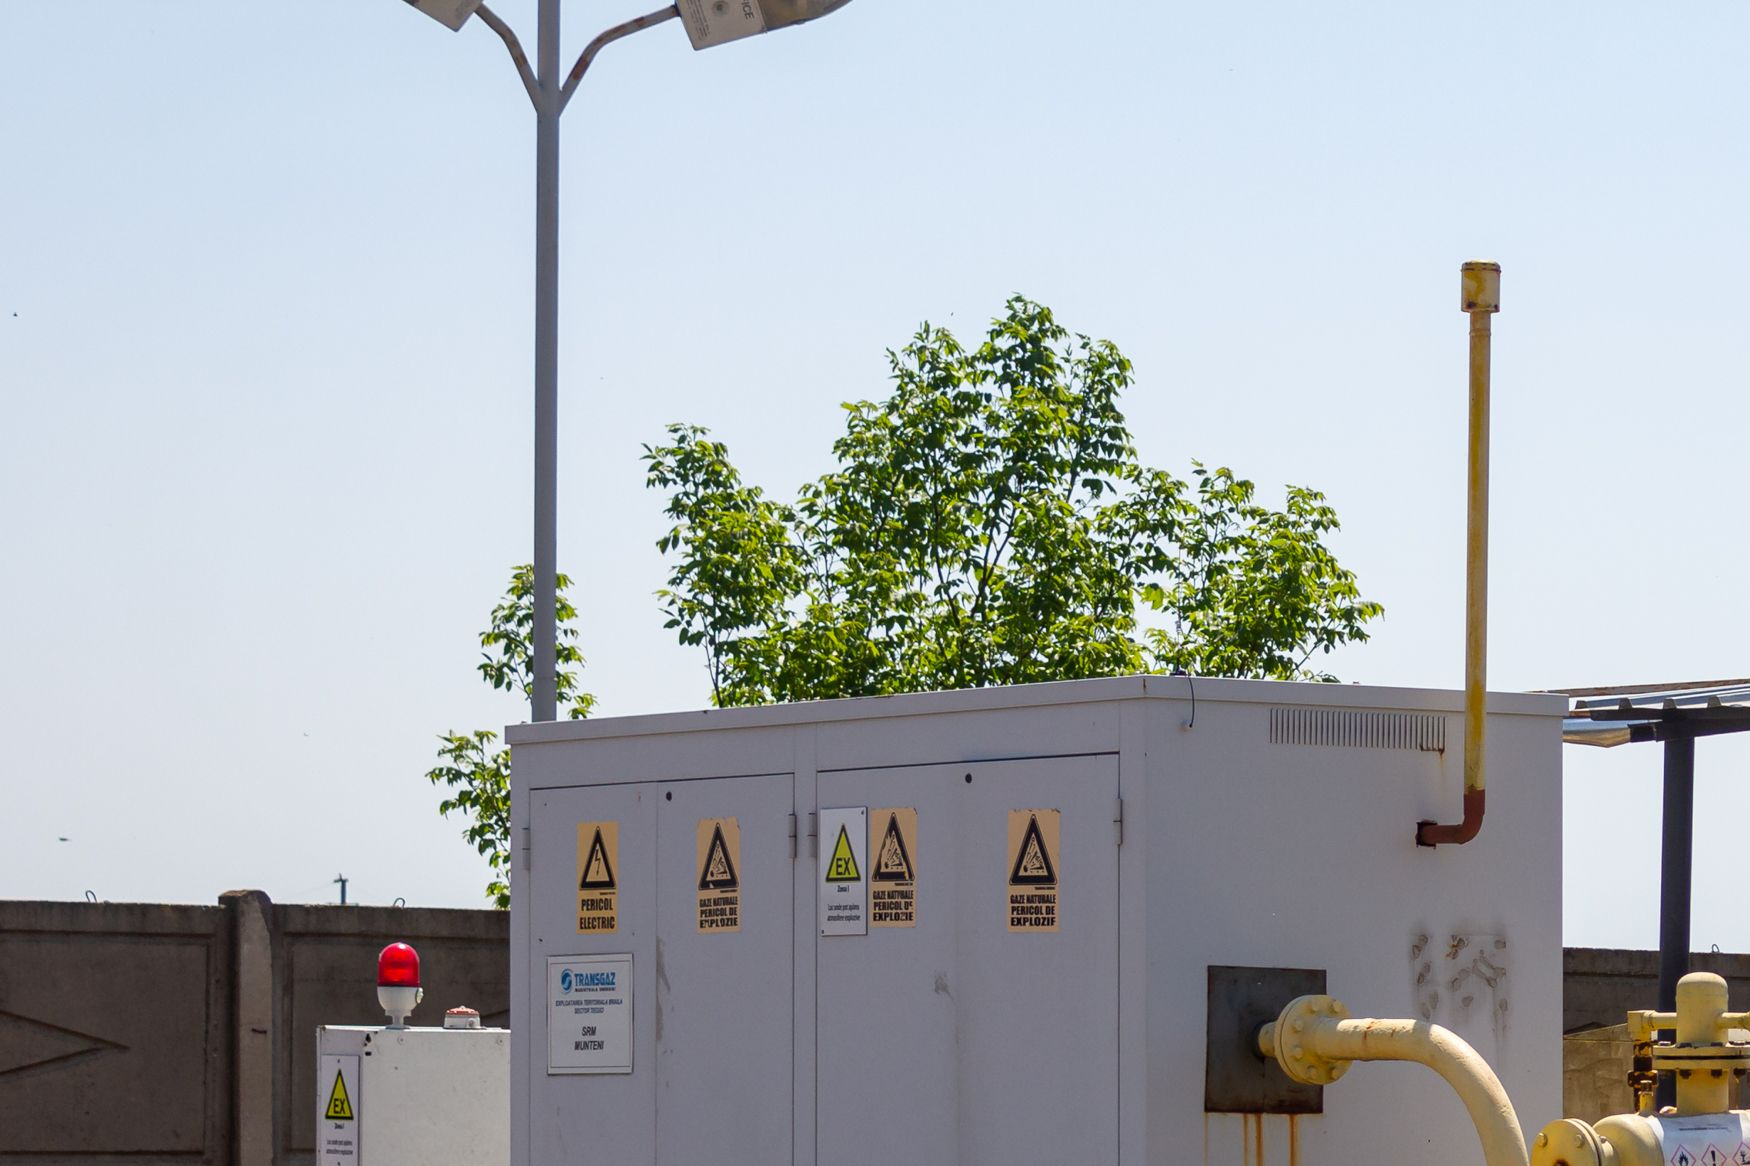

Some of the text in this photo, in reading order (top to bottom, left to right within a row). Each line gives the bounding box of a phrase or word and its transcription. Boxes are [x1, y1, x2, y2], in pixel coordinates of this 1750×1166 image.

[836, 857, 851, 876] EX
[873, 890, 886, 900] GAZE
[1010, 894, 1056, 904] GAZE NATURALE
[581, 898, 613, 911] PERICOL
[699, 896, 738, 908] GAZE NATURALE
[873, 901, 903, 911] PERICOL
[700, 907, 738, 918] PERICOL DE
[1011, 905, 1055, 915] PERICOL DE
[579, 916, 615, 929] ELECTRIC
[574, 972, 616, 986] TRANSGAZ
[581, 1026, 597, 1036] SRM
[574, 1040, 604, 1051] MUNTENI
[333, 1098, 346, 1115] EX
